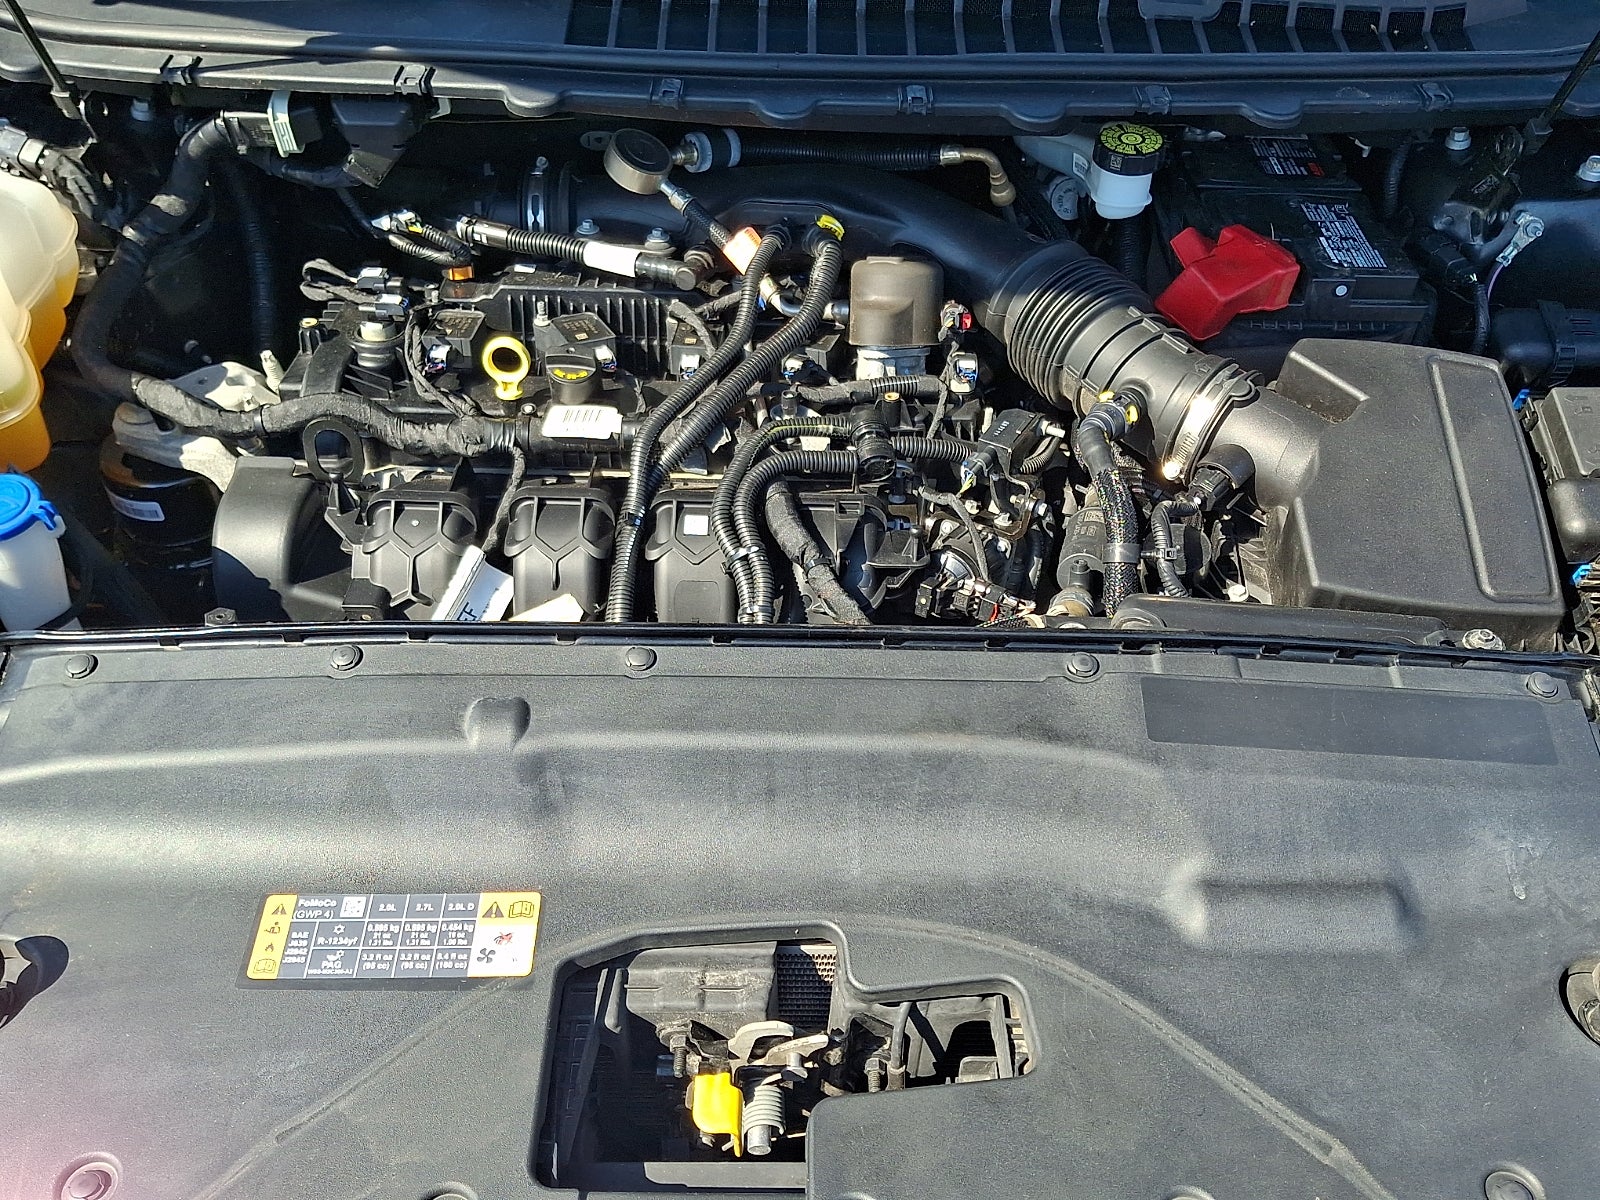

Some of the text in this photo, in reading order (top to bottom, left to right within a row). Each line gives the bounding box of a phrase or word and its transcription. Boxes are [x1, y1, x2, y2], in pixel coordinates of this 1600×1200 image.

[298, 898, 337, 908] FoMoCo
[415, 903, 434, 912] 2.7L
[293, 910, 334, 919] (GWP 4)
[317, 936, 359, 947] R-1234yf
[321, 960, 342, 969] PAG
